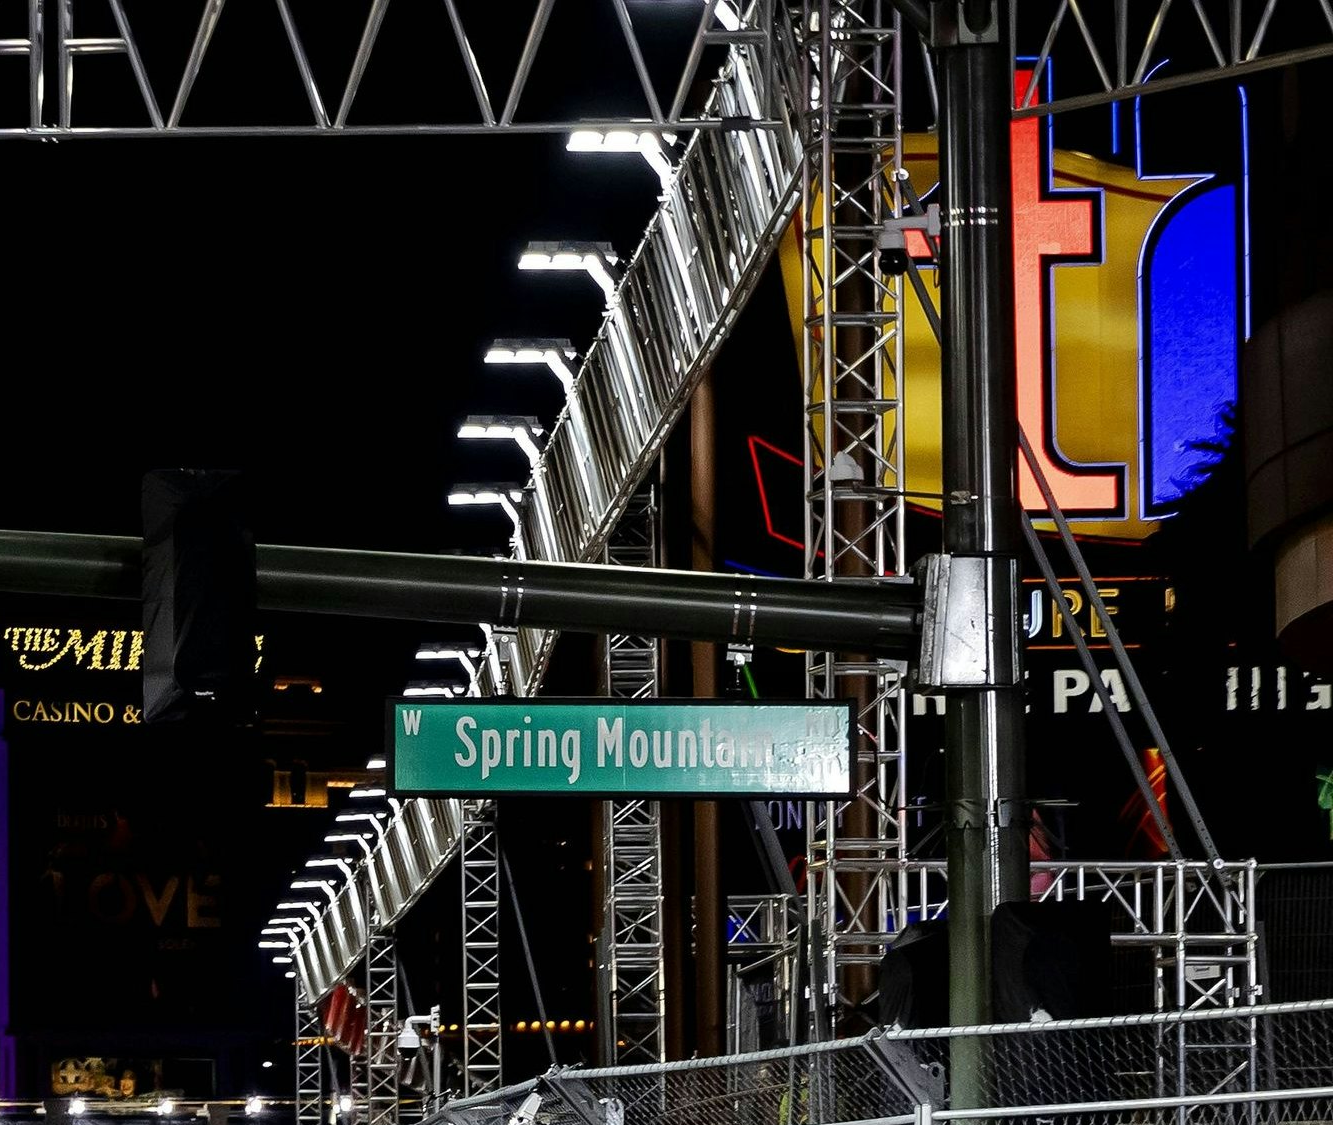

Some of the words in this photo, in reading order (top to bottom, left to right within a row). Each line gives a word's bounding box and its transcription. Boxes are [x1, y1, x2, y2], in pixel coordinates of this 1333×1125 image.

[13, 701, 115, 723] CASINO
[122, 705, 142, 724] &
[402, 709, 422, 736] W
[454, 716, 582, 785] Spring
